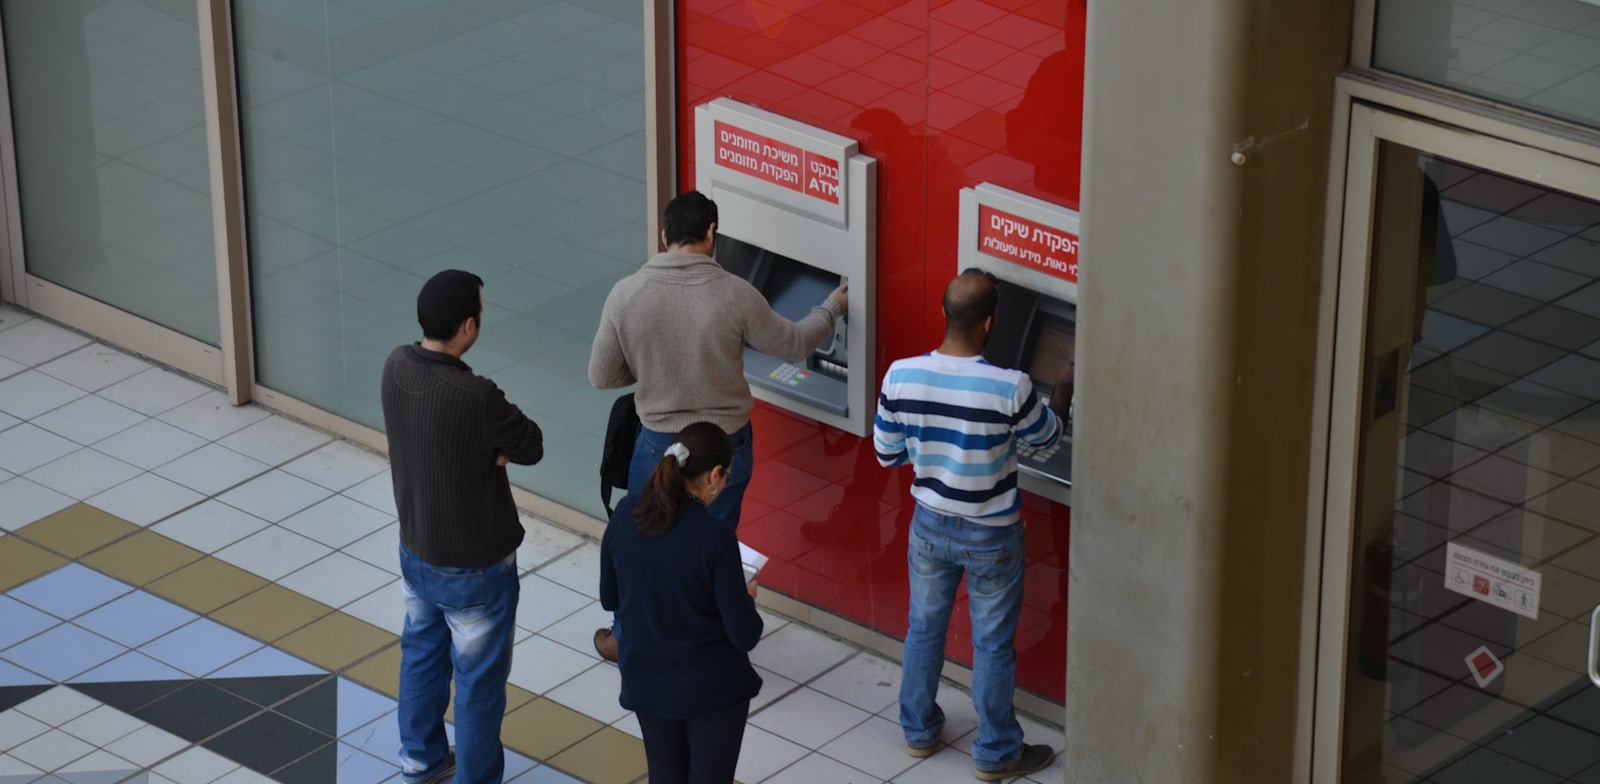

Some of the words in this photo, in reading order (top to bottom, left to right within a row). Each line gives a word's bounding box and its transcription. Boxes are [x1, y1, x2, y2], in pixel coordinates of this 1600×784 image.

[720, 130, 760, 154] מזומנים
[719, 147, 758, 170] מזומנים
[763, 144, 799, 167] משיכת
[760, 161, 799, 184] הפקדת
[810, 159, 839, 180] בנקט
[808, 177, 839, 198] ATM
[991, 214, 1029, 239] שיקים
[983, 236, 1018, 256] ופעולות
[1032, 228, 1079, 255] הפקדת
[1019, 247, 1041, 264] מידע
